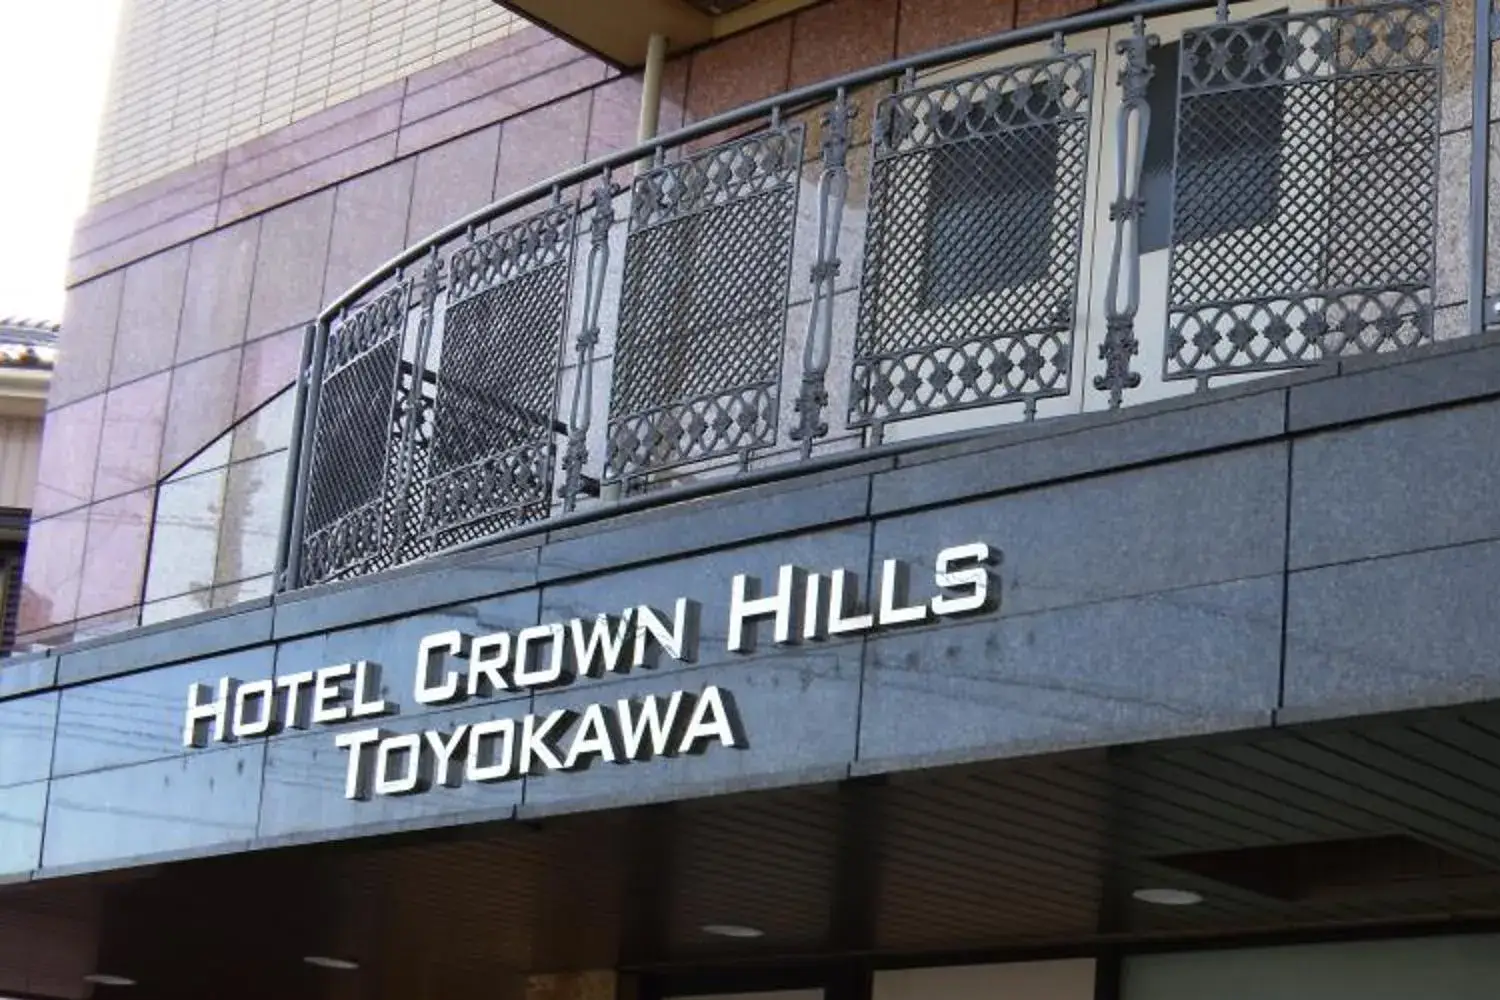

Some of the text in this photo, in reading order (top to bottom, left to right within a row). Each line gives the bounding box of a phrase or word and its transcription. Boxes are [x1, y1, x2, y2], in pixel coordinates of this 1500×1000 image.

[183, 541, 992, 747] HOTEL CROWN HILLS
[335, 685, 736, 800] TOYOKAWA
